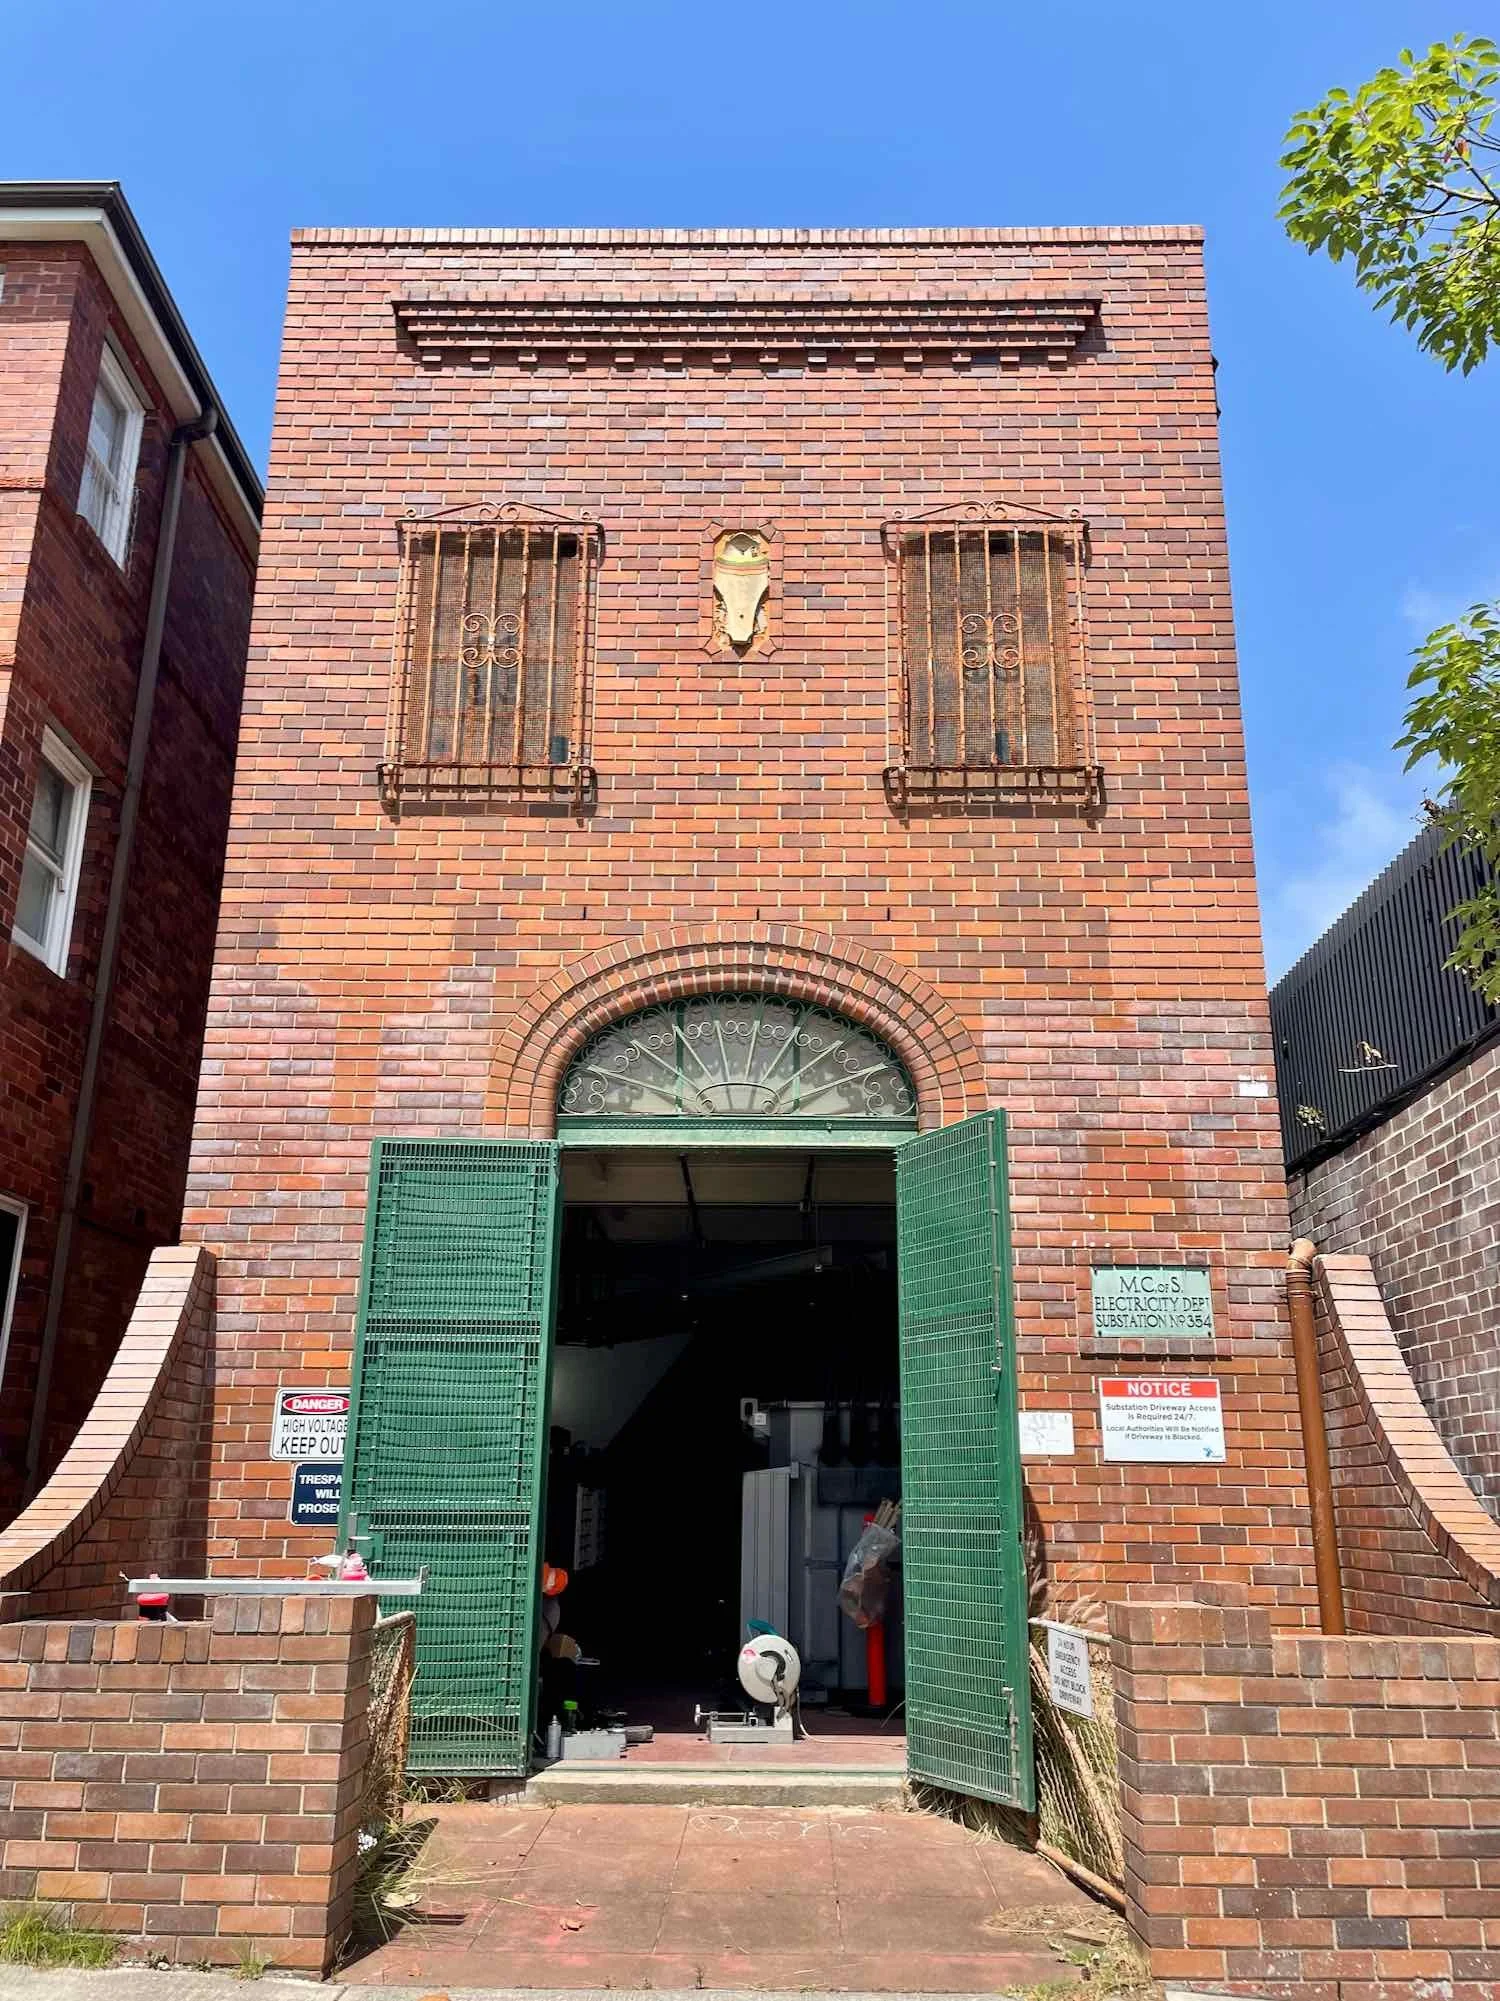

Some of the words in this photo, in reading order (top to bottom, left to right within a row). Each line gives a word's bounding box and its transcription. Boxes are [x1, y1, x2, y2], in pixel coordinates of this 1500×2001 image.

[1094, 1296, 1180, 1312] ELECTRICITY
[1095, 1314, 1167, 1328] SUBSTATION
[1127, 1382, 1192, 1396] NOTICE
[292, 1399, 344, 1410] DANGER
[1105, 1403, 1148, 1411] Substation
[1150, 1403, 1186, 1412] Driveway
[1189, 1404, 1217, 1412] Access
[1136, 1413, 1173, 1422] Required
[1174, 1413, 1196, 1421] 24/7.
[282, 1419, 305, 1433] HIGH
[1131, 1433, 1163, 1441] Driveway
[280, 1437, 317, 1454] KEEP
[319, 1437, 347, 1454] OUT
[315, 1488, 341, 1499] WILL
[1055, 1649, 1080, 1665] EMERGENCY
[1070, 1679, 1087, 1695] BLOCK
